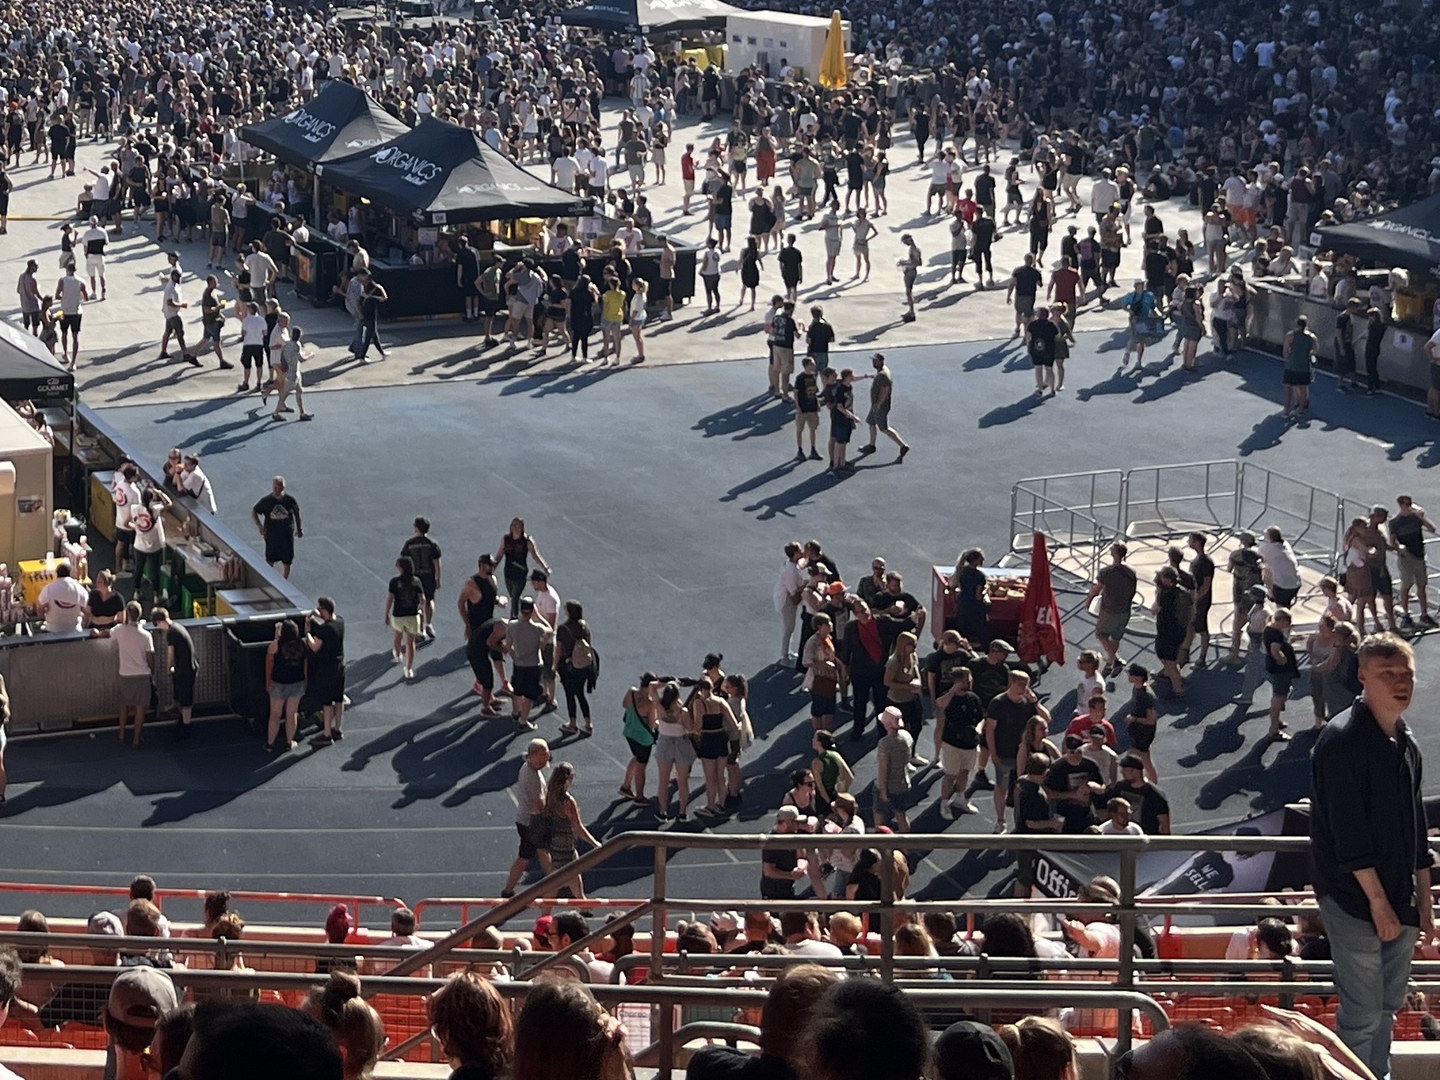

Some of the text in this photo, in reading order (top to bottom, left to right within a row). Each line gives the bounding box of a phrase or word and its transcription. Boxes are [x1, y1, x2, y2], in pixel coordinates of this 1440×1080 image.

[375, 146, 442, 180] ORGANICS
[1184, 868, 1208, 891] SELL
[1201, 864, 1219, 879] WE
